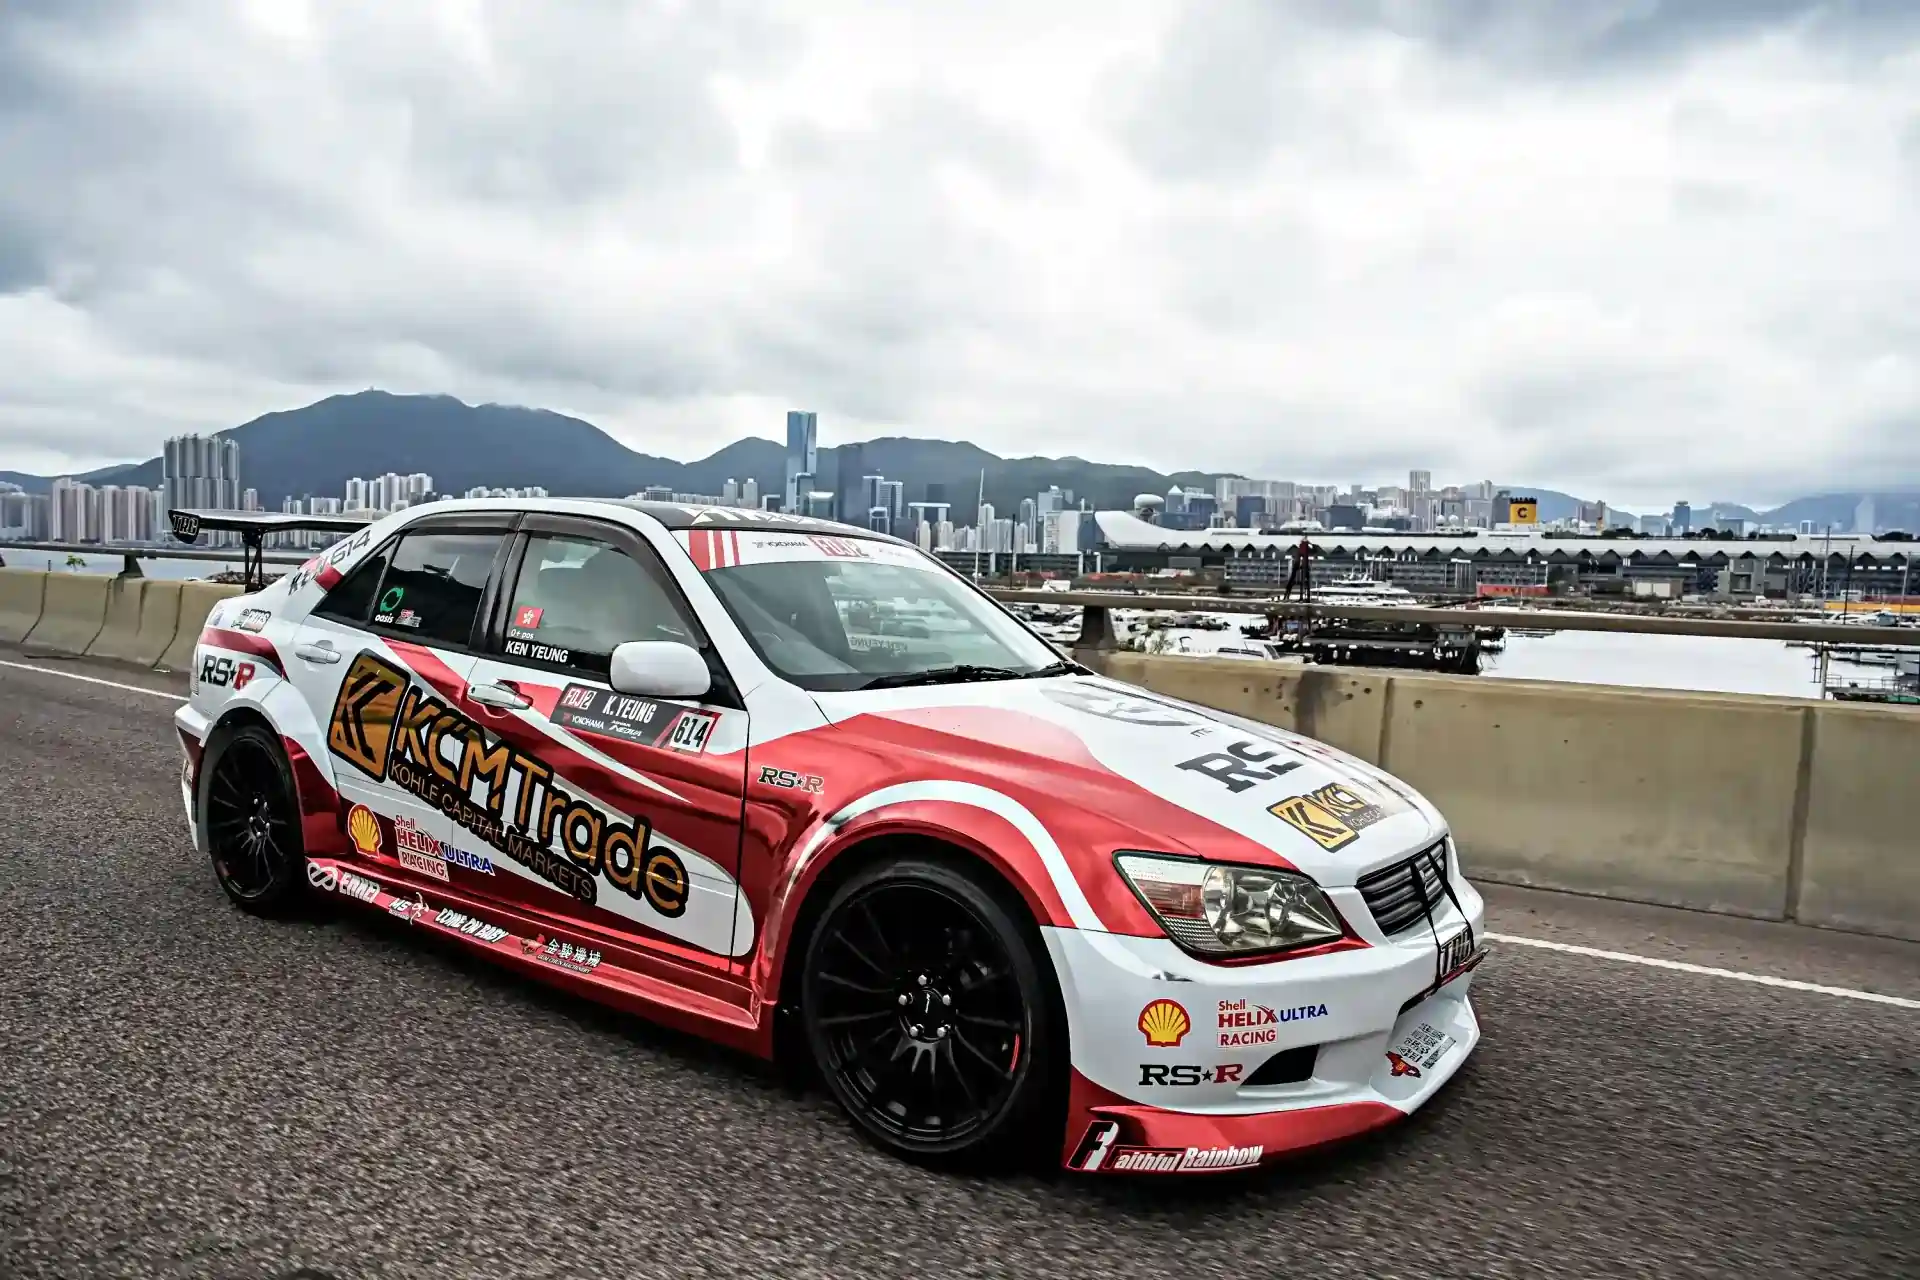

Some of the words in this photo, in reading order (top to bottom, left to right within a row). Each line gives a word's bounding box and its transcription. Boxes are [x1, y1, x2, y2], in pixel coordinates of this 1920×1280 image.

[330, 529, 371, 565] 614
[375, 613, 394, 624] oasis
[505, 640, 529, 656] KEN
[530, 644, 569, 663] YEUNG
[571, 714, 604, 729] YOKOHAMA
[602, 695, 658, 724] K.YEUNG
[673, 716, 710, 748] 614
[391, 760, 439, 800] KOHLE
[442, 793, 503, 847] CAPITAL
[508, 835, 592, 899] MARKETS
[395, 814, 415, 830] Shell
[395, 828, 443, 857] HELIX
[444, 843, 495, 875] ULTRA
[402, 851, 446, 878] RACING
[460, 917, 483, 934] ON
[474, 924, 510, 943] BABY
[1218, 999, 1246, 1011] Shell
[1218, 1007, 1280, 1028] HELIX
[1280, 1003, 1328, 1022] ULTRA
[1219, 1029, 1277, 1046] RACING
[1177, 1145, 1264, 1171] Rainbow
